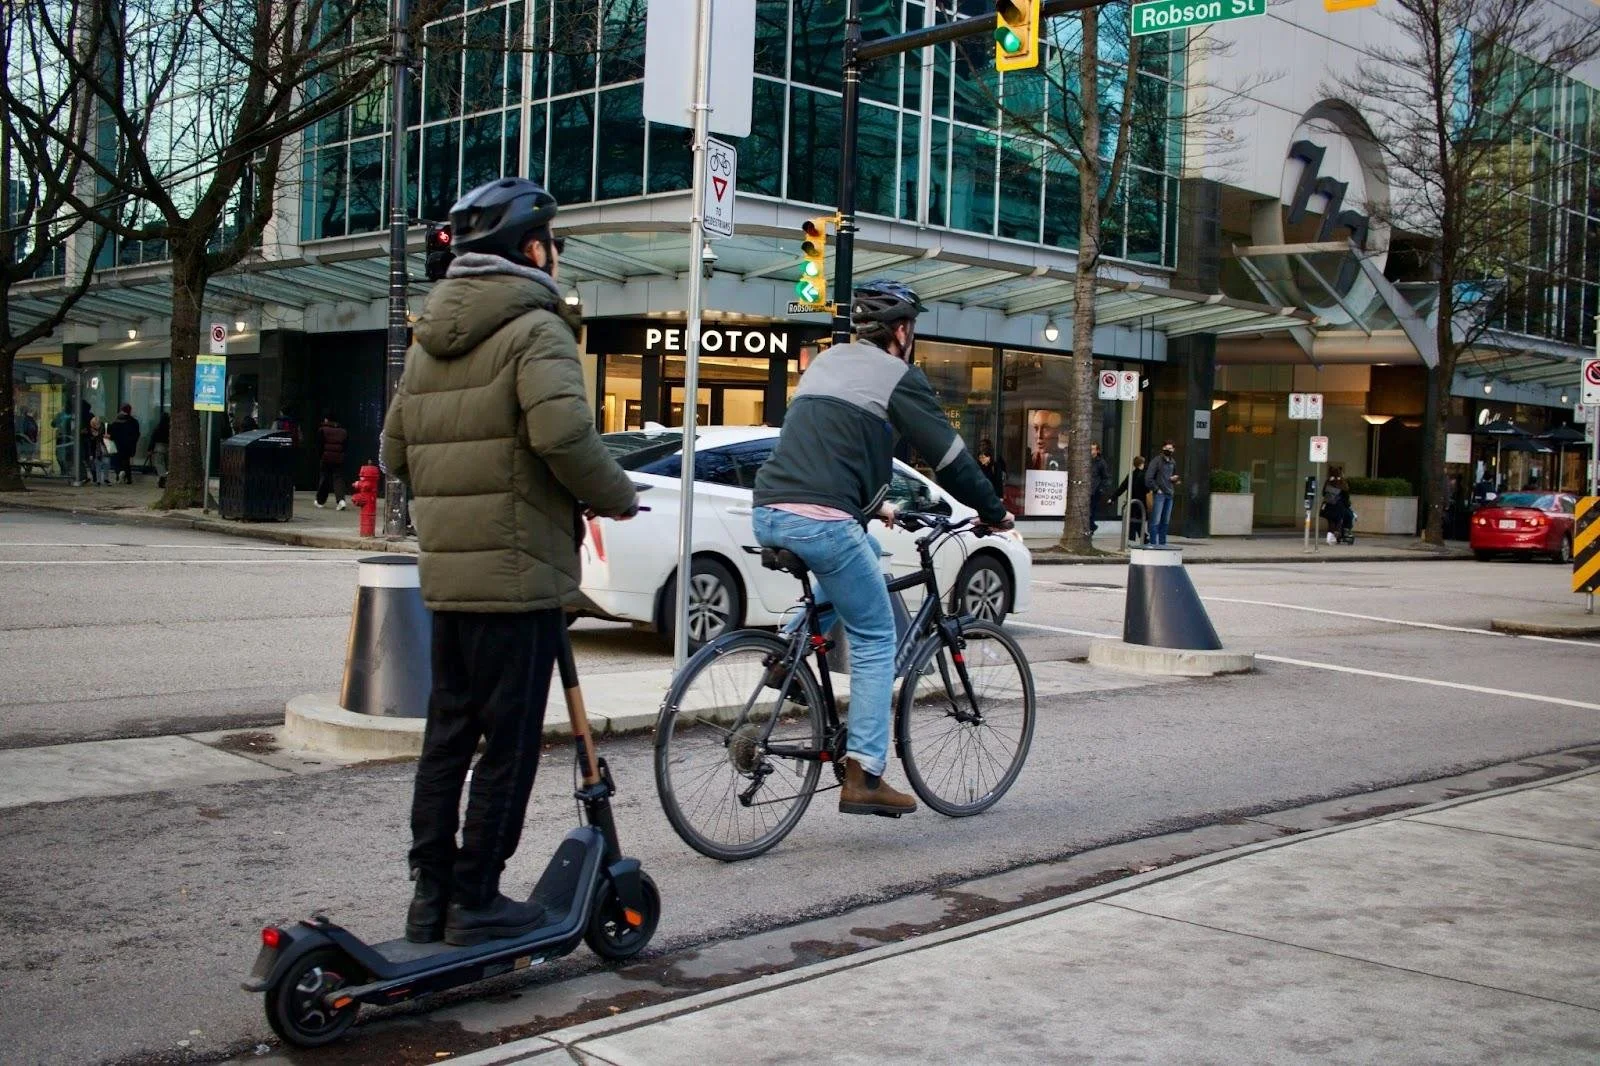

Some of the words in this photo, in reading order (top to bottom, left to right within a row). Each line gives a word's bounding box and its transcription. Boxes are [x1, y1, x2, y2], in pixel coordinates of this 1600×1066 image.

[1141, 1, 1221, 28] Robson
[1231, 0, 1256, 14] St
[646, 328, 788, 354] PEOTON
